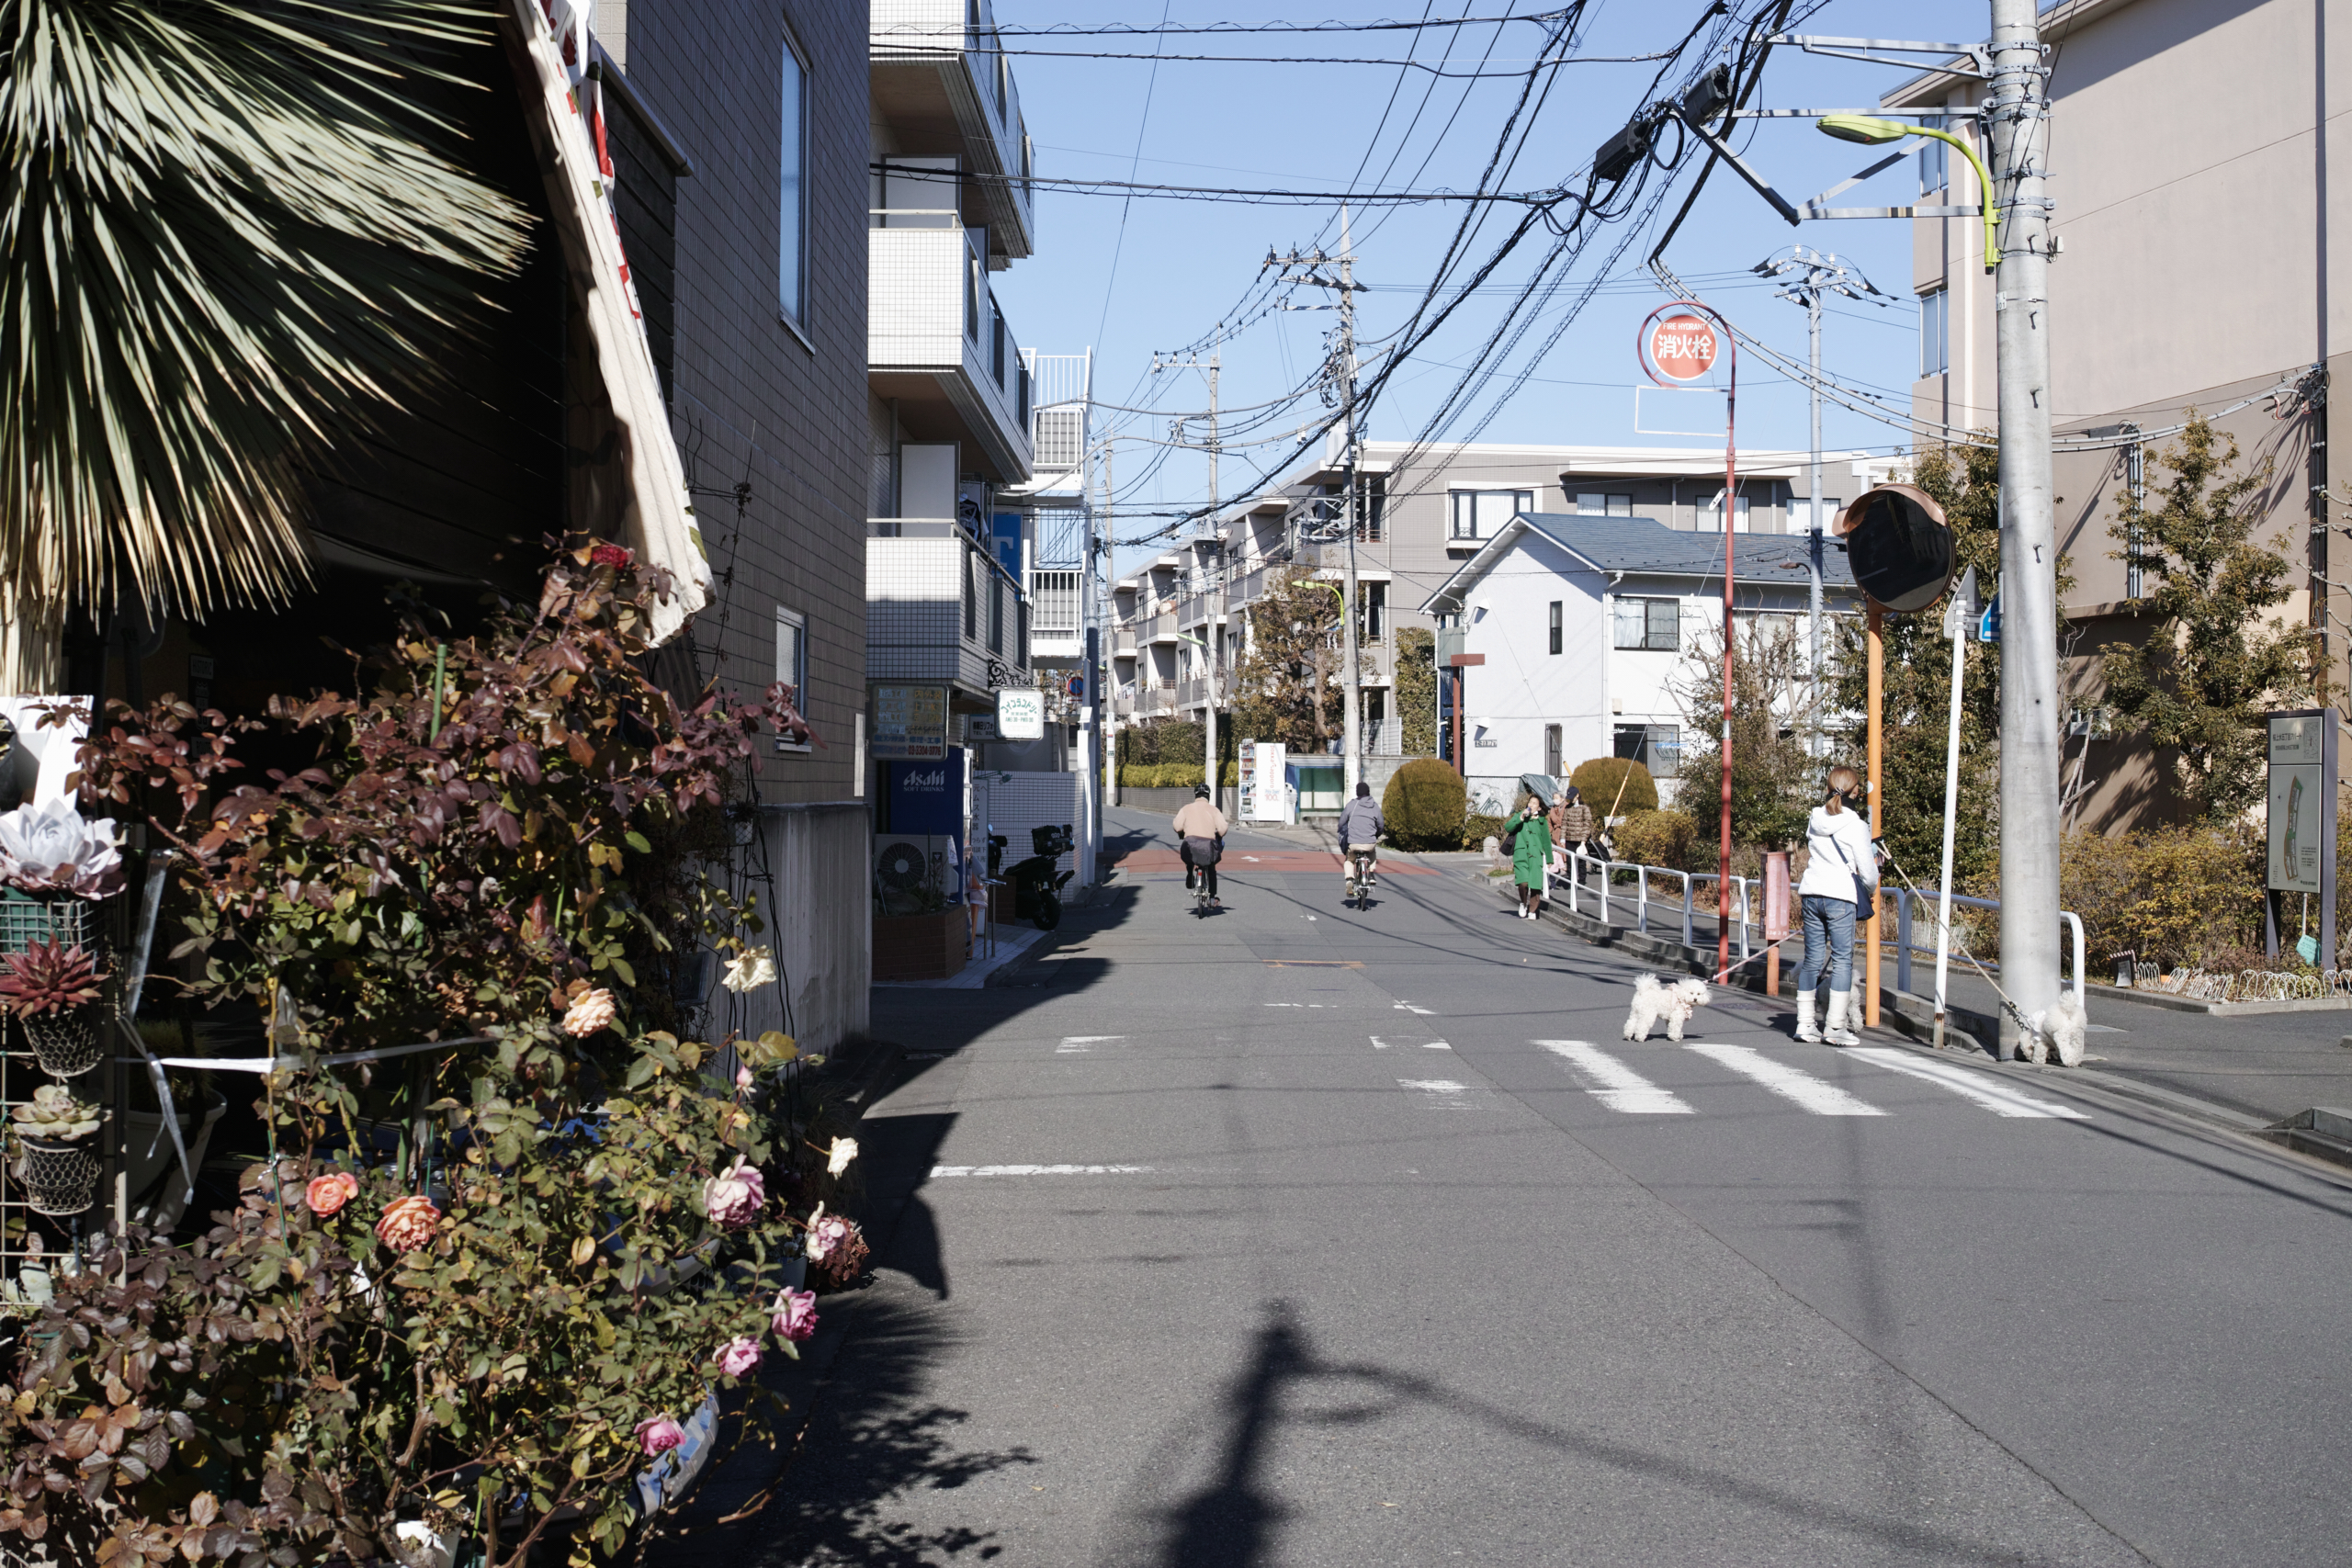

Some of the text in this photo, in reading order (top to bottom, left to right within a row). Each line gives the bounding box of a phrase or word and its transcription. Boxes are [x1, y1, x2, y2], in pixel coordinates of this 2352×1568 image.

[1663, 322, 1706, 331] FIRE HYDRANT
[1657, 334, 1712, 360] 消火栓
[191, 659, 212, 676] HISTORIC
[903, 770, 944, 786] Asahi
